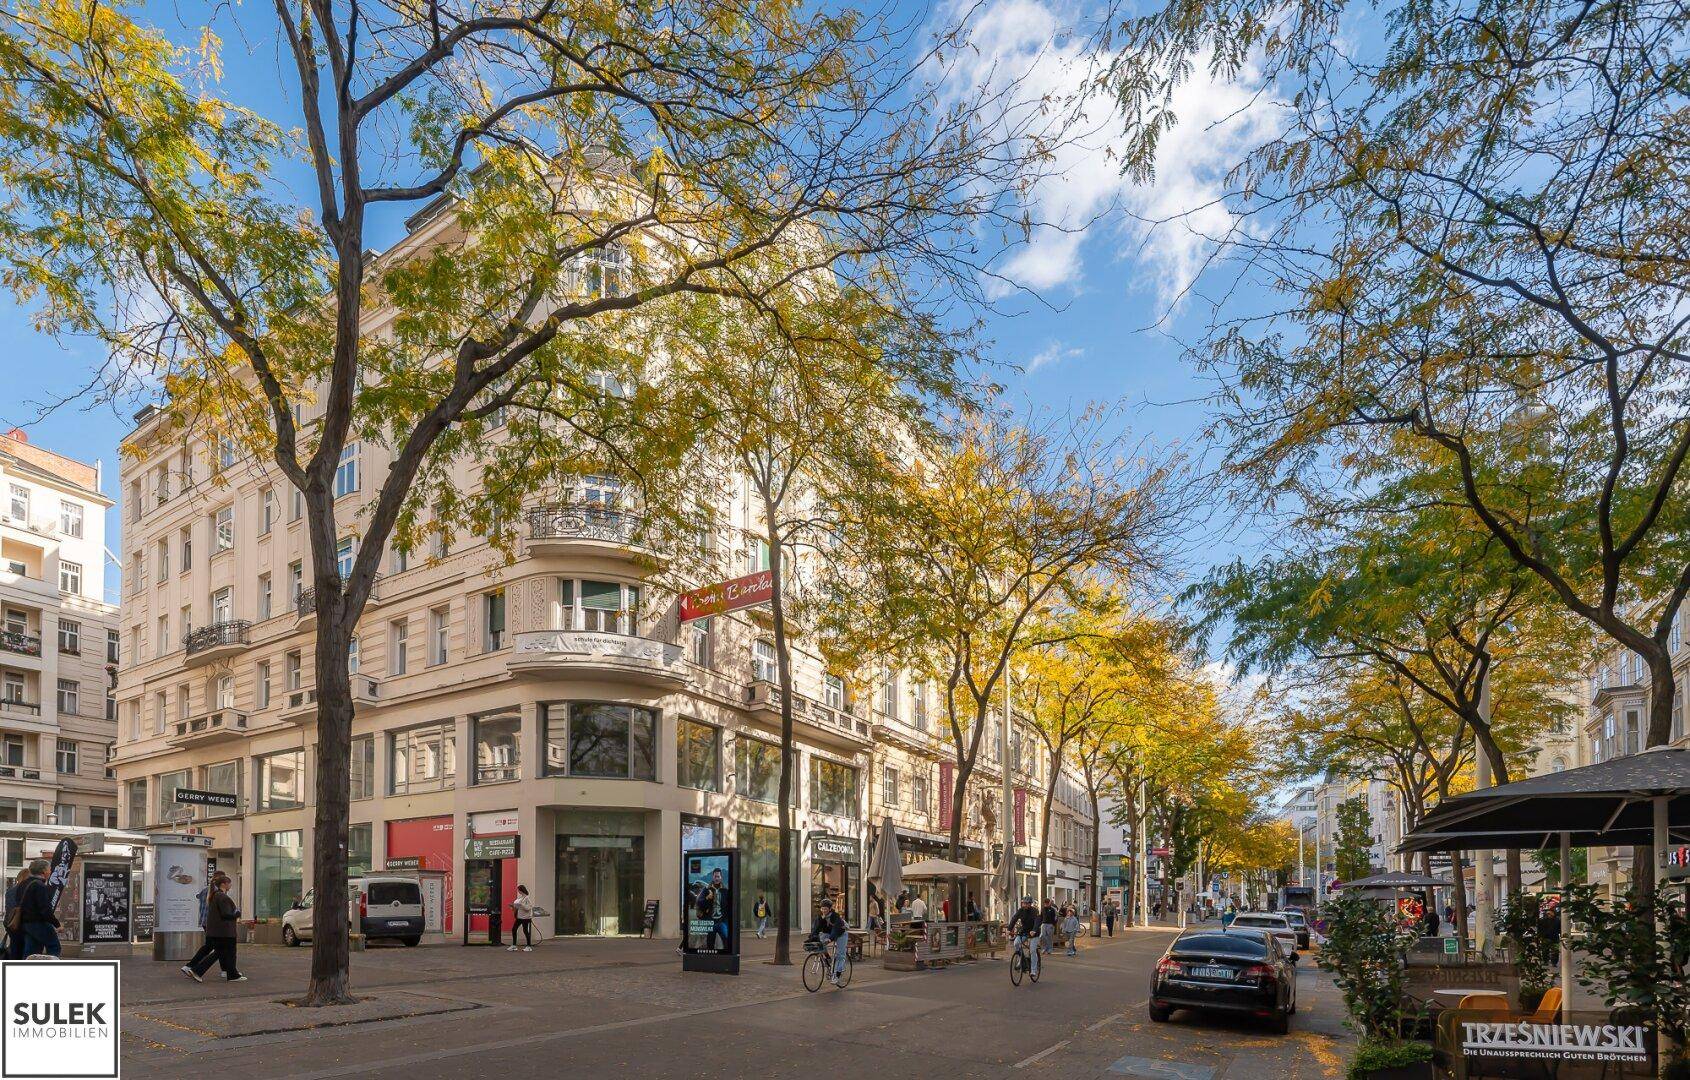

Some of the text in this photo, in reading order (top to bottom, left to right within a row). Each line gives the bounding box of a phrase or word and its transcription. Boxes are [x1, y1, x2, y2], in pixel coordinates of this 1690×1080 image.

[602, 639, 627, 647] dichtung
[177, 792, 236, 804] GERRY WEBER
[817, 842, 854, 855] CALZEDONIA
[1462, 1021, 1645, 1050] TRZEŚNIEWSKI
